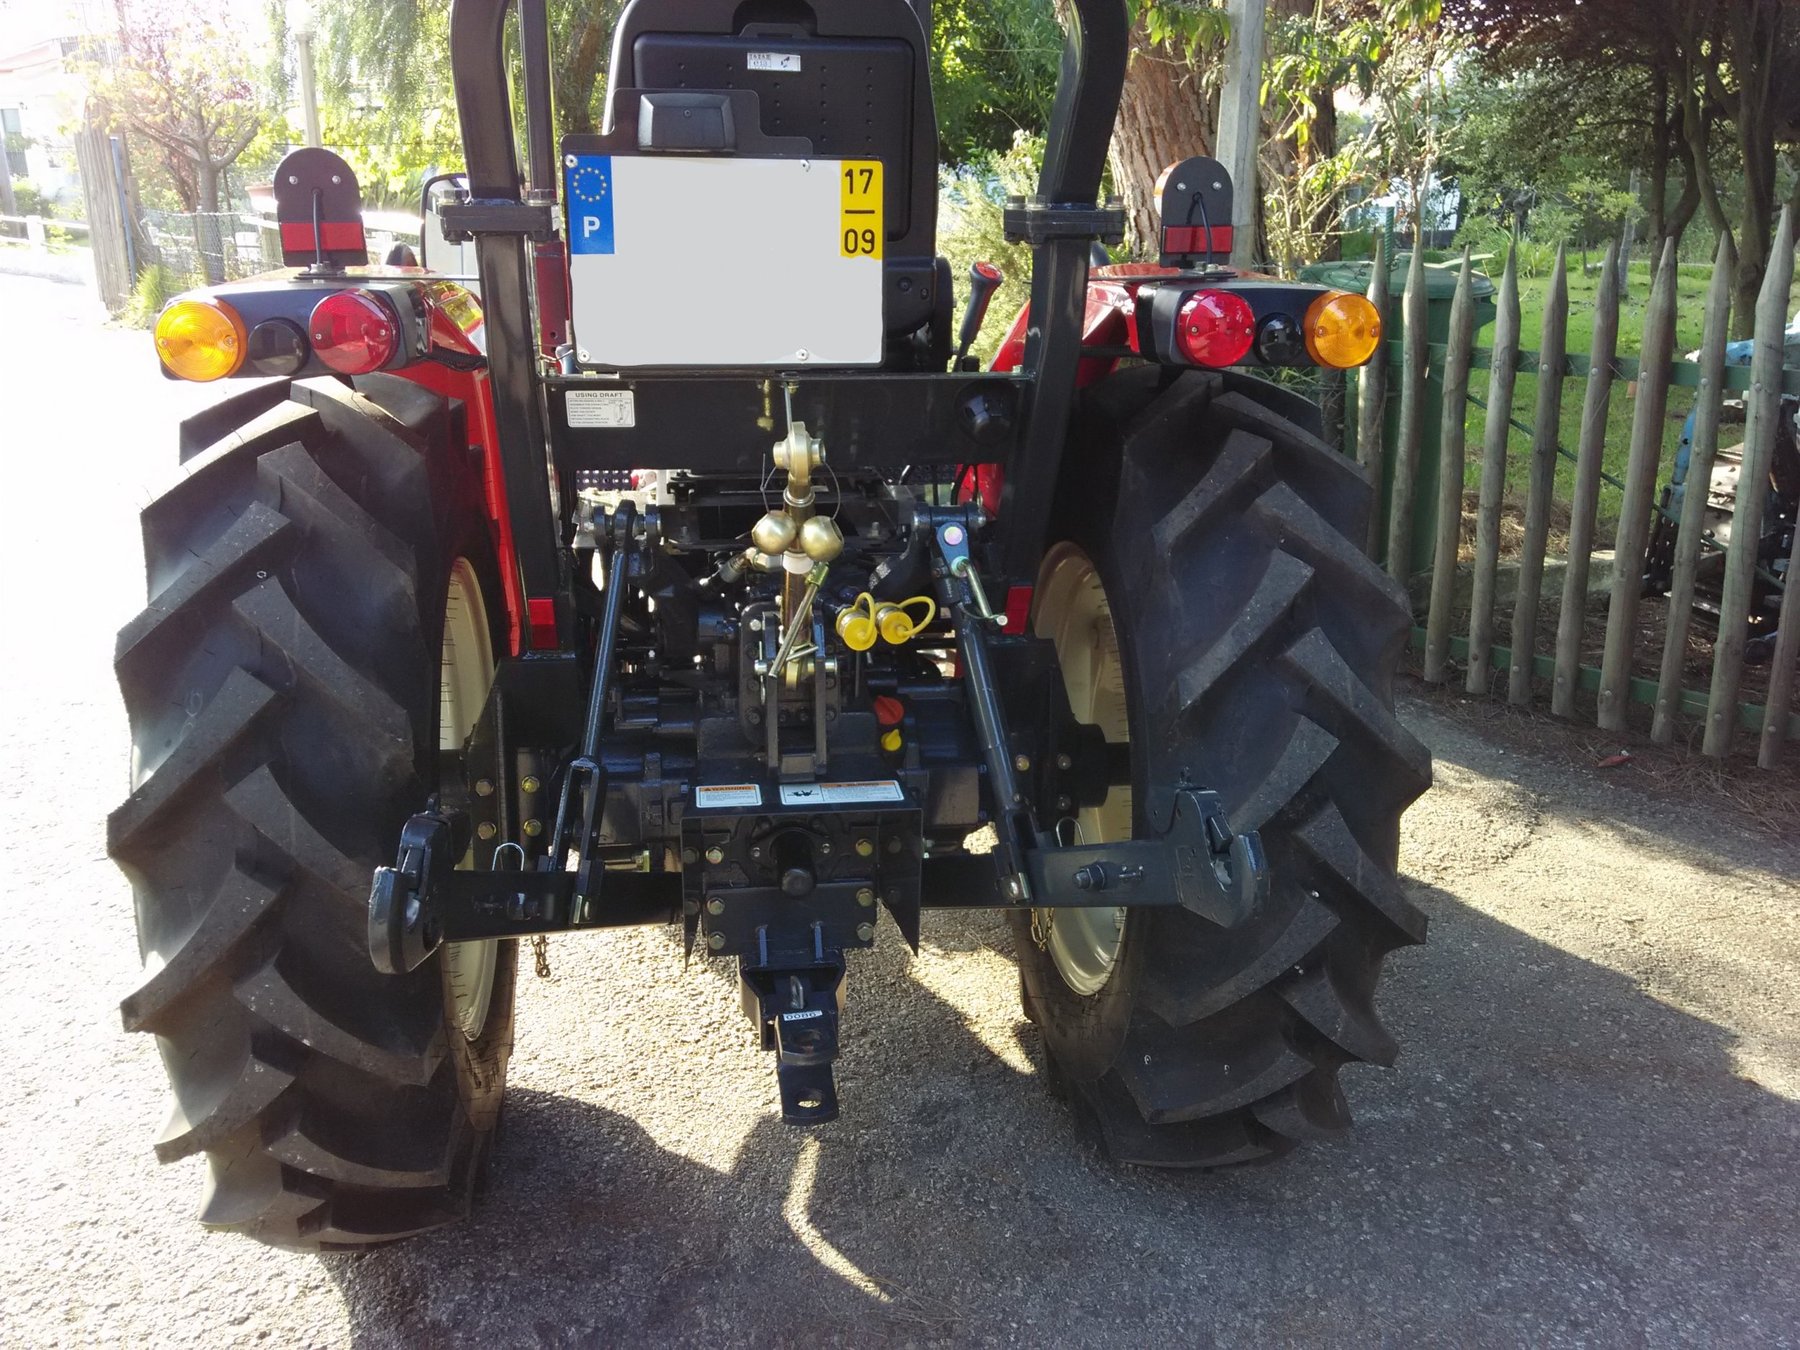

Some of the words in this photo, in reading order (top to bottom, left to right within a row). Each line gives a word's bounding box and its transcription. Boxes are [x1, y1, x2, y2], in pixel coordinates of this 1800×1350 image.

[844, 168, 874, 195] 17
[583, 216, 600, 238] P
[844, 229, 875, 254] 09
